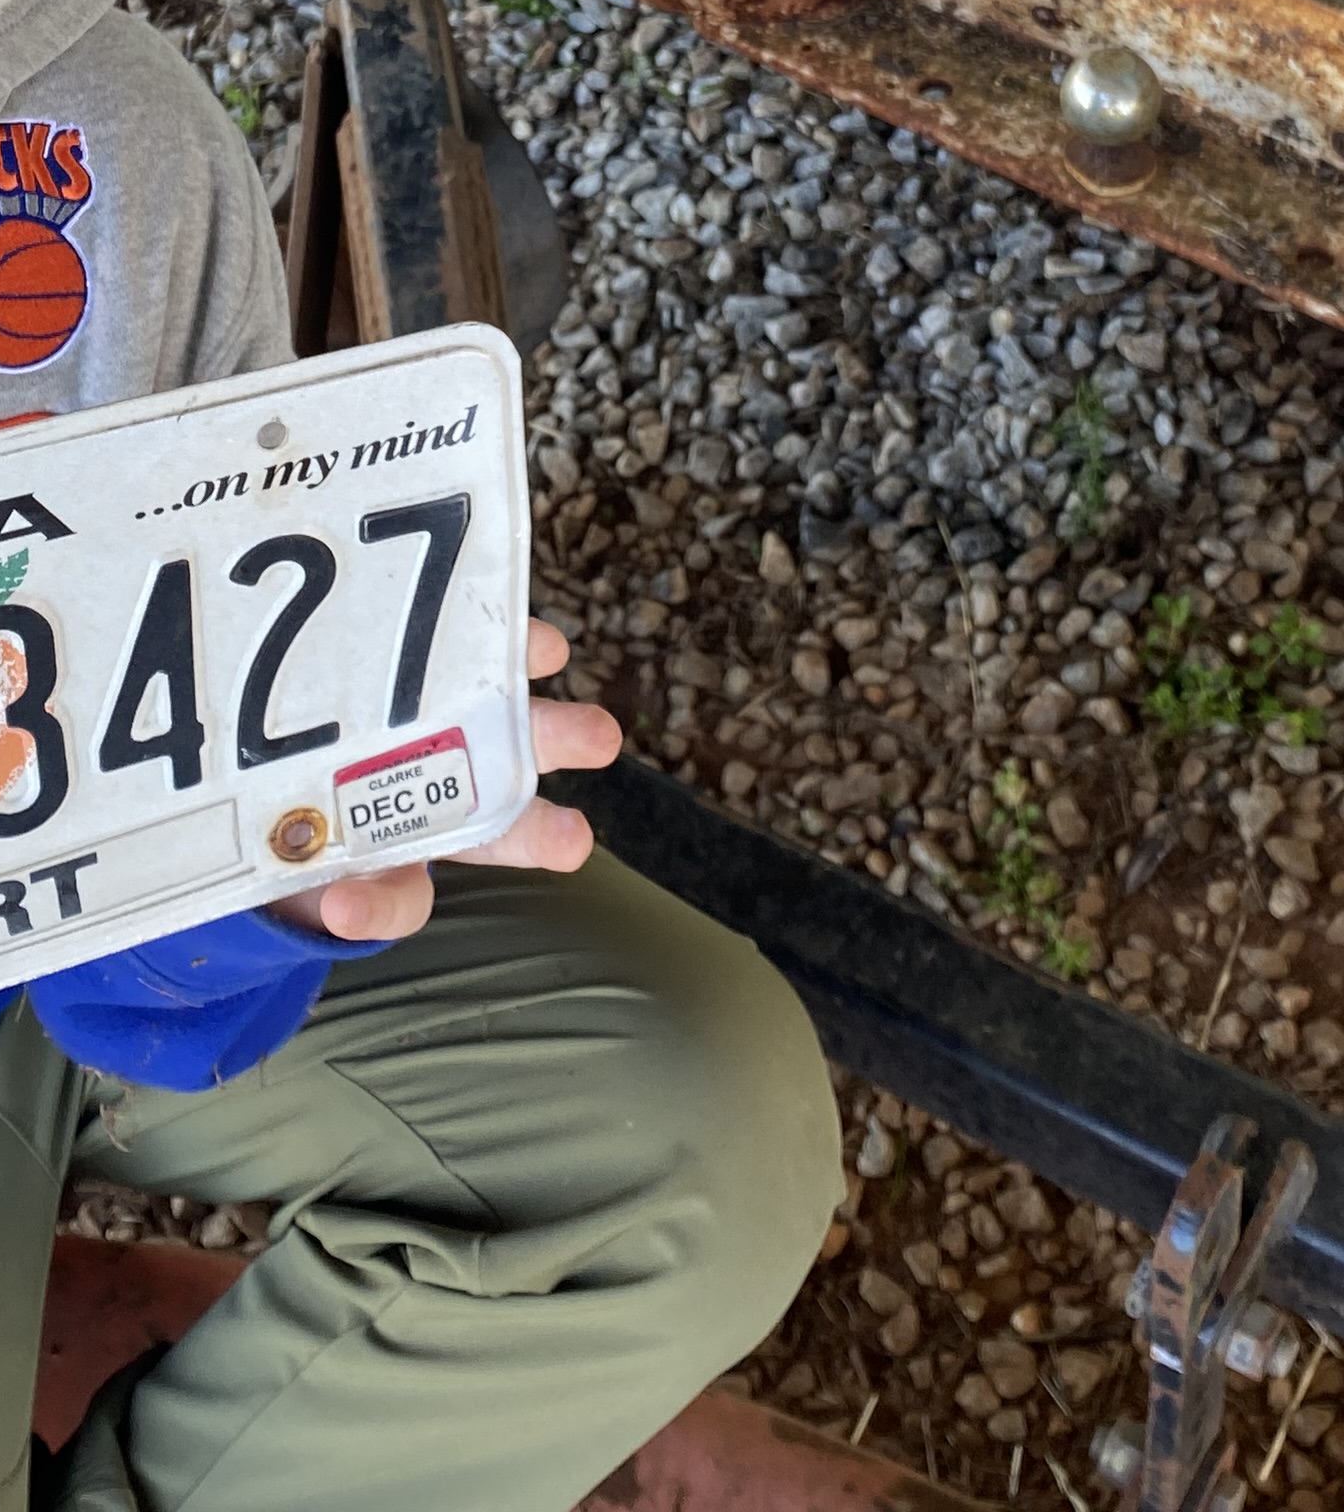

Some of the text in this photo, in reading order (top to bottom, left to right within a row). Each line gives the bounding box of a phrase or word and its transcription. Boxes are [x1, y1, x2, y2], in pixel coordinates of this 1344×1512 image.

[261, 448, 340, 492] my
[351, 404, 479, 470] mind
[349, 776, 460, 829] DEC 08
[368, 765, 424, 791] CLARKE
